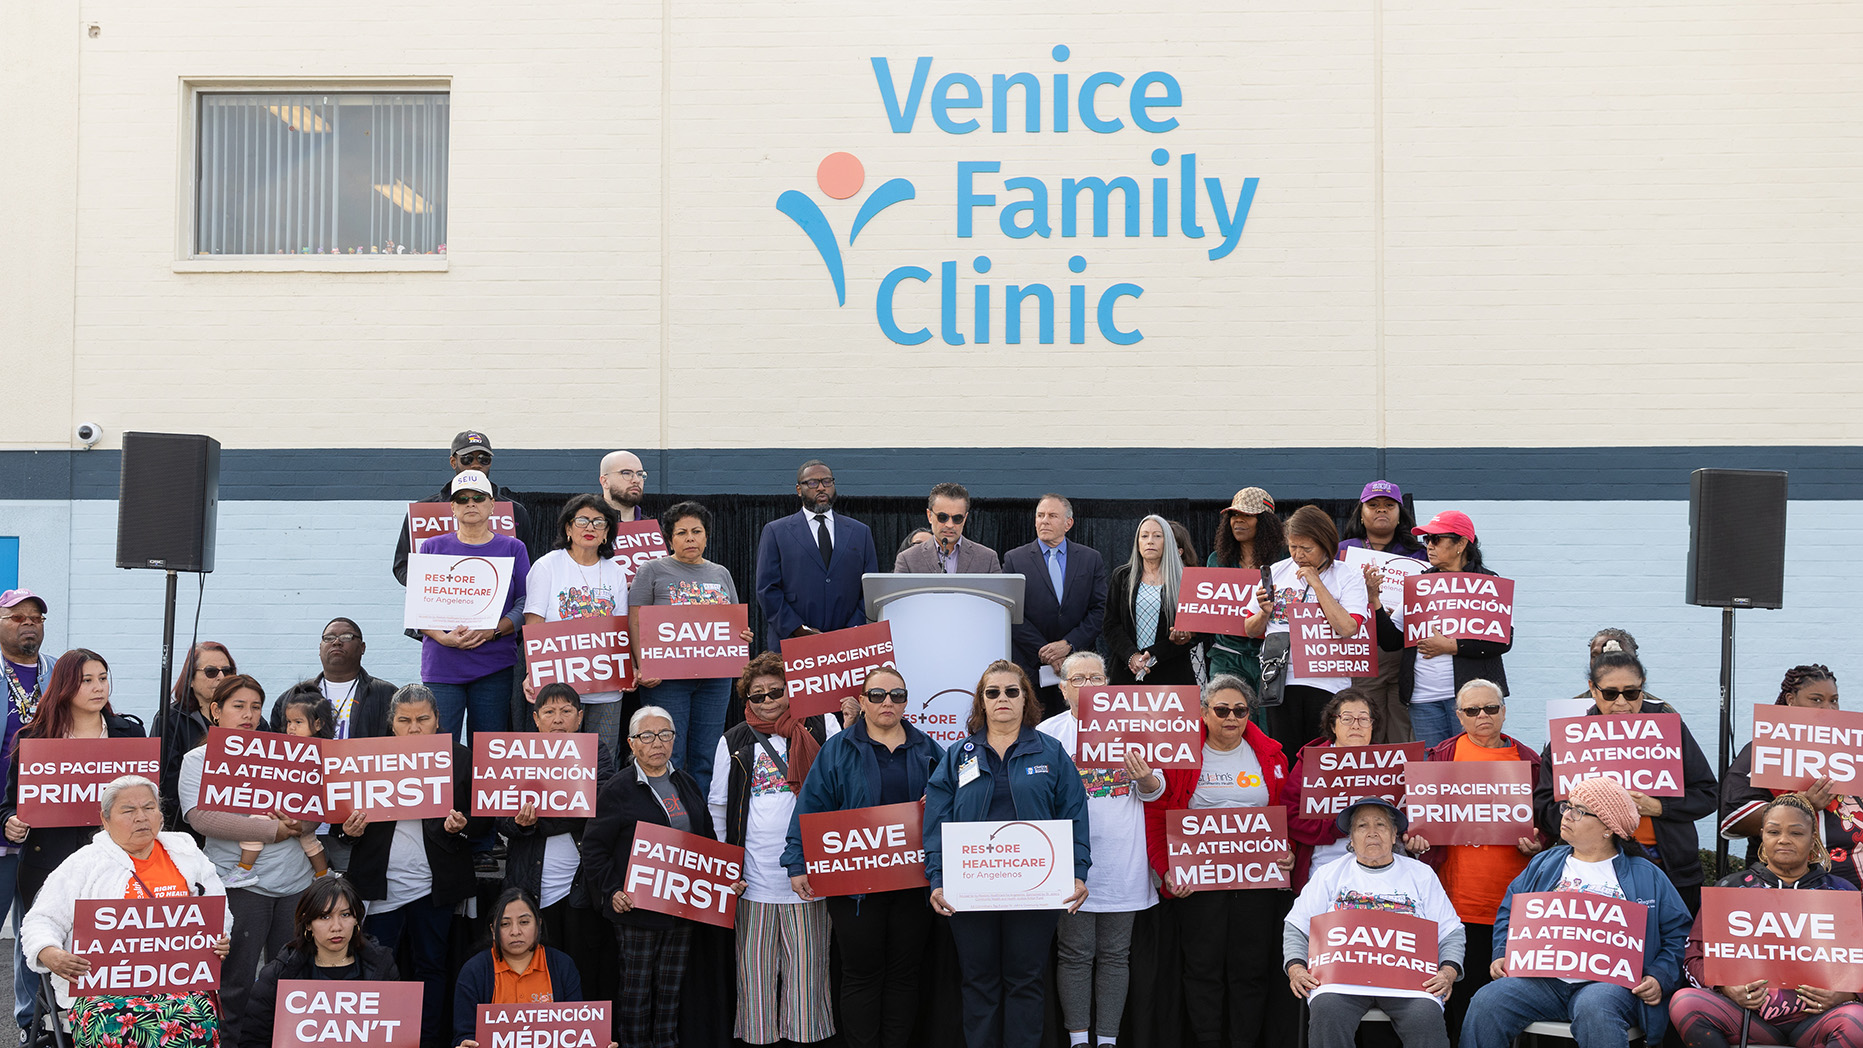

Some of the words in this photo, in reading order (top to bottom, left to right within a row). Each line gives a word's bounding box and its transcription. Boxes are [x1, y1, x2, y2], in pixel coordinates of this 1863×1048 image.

[870, 44, 1182, 134] Venice
[956, 148, 1260, 260] Family
[876, 256, 1144, 346] Clinic
[458, 475, 478, 485] SEIU
[412, 515, 514, 532] PATITS
[424, 586, 492, 596] HEALTHCARE
[1416, 578, 1498, 596] SALVA
[436, 596, 474, 606] Angelenos
[1177, 602, 1248, 618] HEALTHC
[1404, 602, 1424, 616] LA
[1426, 598, 1512, 616] ATENCIÓN
[1294, 608, 1310, 618] LA
[658, 622, 730, 642] SAVE
[1408, 618, 1506, 640] MÉDICA
[526, 630, 628, 656] PATIENTS
[640, 646, 748, 660] HEALTHCARE
[1304, 644, 1328, 656] NO
[1330, 644, 1370, 656] PUEDE
[784, 658, 814, 672] LOS
[816, 641, 894, 667] PACIENTES
[1308, 660, 1370, 672] ESPERAR
[530, 652, 630, 688] FIRST
[1092, 692, 1184, 712] SALVA
[1078, 720, 1102, 732] LA
[1104, 716, 1200, 732] ATENCIÓN
[1564, 720, 1664, 744] SALVA
[1754, 720, 1863, 747] PATIENT
[224, 736, 322, 764] SALVA
[488, 738, 582, 760] SALVA
[1082, 738, 1196, 762] MÉDICA
[1320, 750, 1408, 770] SALVA
[1552, 750, 1576, 766] LA
[1580, 744, 1680, 762] ATENCIÓN
[20, 762, 56, 774] LOS
[60, 760, 160, 774] PACIENTES
[324, 750, 452, 774] PATIENTS
[474, 766, 496, 780] LA
[500, 764, 596, 780] ATENCIÓN
[204, 760, 230, 776] LA
[234, 764, 324, 788] ATENCIÓ
[1236, 771, 1261, 788] 60
[1304, 776, 1328, 788] LA
[1330, 771, 1406, 788] ATENCIÓ
[204, 782, 324, 817] MÉDICA
[326, 776, 450, 810] FIRST
[478, 784, 590, 810] MÉDICA
[1406, 784, 1438, 796] LOS
[1440, 782, 1532, 796] PACIENTES
[1408, 804, 1532, 822] PRIMERO
[1182, 814, 1272, 836] SALVA
[822, 824, 906, 854] SAVE
[1168, 842, 1192, 856] LA
[1196, 836, 1286, 854] ATENCIÓN
[632, 838, 740, 880] PATIENTS
[806, 850, 926, 874] HEALTHCARE
[962, 858, 1046, 868] HEALTHCARE
[962, 871, 974, 880] for
[976, 871, 1022, 880] Angelenos
[1176, 860, 1284, 886] MÉDICA
[626, 864, 736, 914] FIRST
[94, 904, 206, 930] SALVA
[1526, 898, 1628, 928] SALVA
[1728, 910, 1836, 940] SAVE
[74, 940, 104, 954] LA
[108, 930, 222, 954] ATENCIÓN
[1326, 926, 1416, 954] SAVE
[1508, 926, 1532, 940] LA
[1536, 926, 1644, 952] ATENCIÓN
[1308, 950, 1438, 976] HEALTHCARE
[1508, 944, 1636, 984] MÉDICA
[1704, 942, 1863, 964] HEALTHCARE
[78, 960, 214, 990] MÉDICA
[284, 990, 380, 1014] CARE
[486, 1010, 510, 1024] LA
[514, 1004, 604, 1024] ATENCIÓN
[295, 1020, 400, 1044] CAN'T
[492, 1026, 596, 1048] MÉDICA
